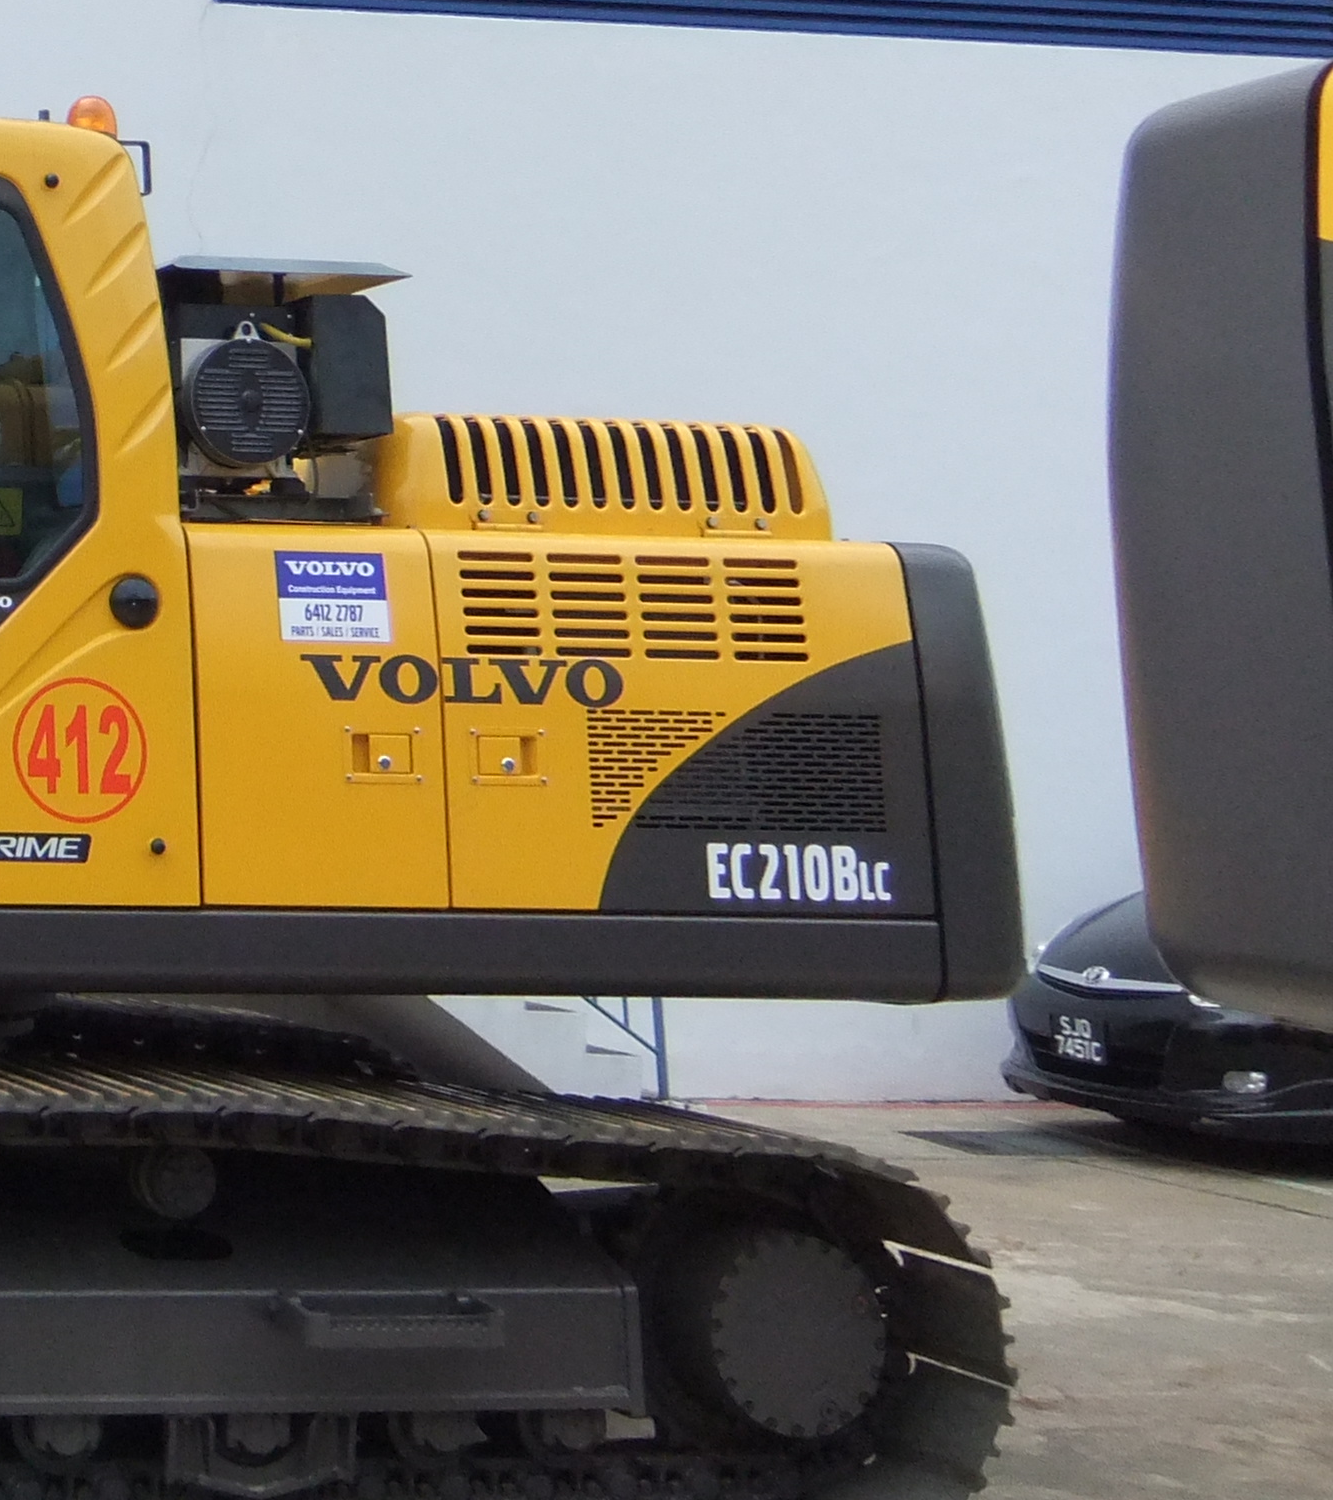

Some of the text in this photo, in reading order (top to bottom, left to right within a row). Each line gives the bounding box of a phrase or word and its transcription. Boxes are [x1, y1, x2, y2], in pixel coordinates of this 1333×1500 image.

[283, 560, 375, 577] VOLVO
[304, 603, 364, 623] 6412 2787
[290, 626, 315, 638] PARTS
[321, 626, 344, 638] SALES
[350, 627, 381, 639] SERVICE
[300, 654, 624, 708] VOLVO
[27, 704, 132, 794] 412
